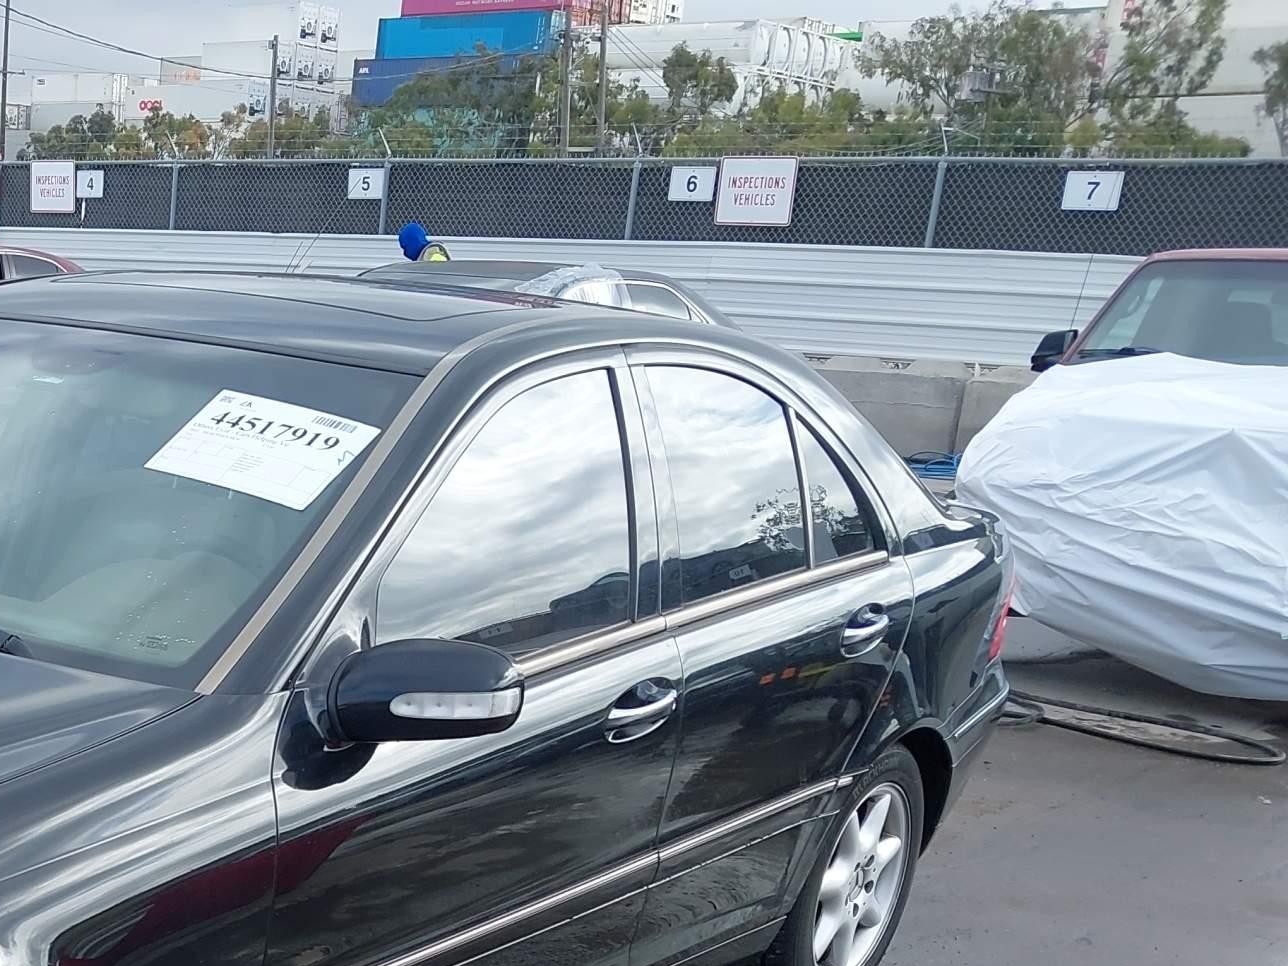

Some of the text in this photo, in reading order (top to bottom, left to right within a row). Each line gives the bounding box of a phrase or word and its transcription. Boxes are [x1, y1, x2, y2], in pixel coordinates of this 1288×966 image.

[35, 175, 70, 185] INSPECTIONS
[86, 177, 94, 191] 4
[361, 176, 371, 192] 5
[686, 174, 698, 193] 6
[727, 175, 787, 190] INSPECTIONS
[39, 188, 65, 198] VEHICLES
[1087, 181, 1101, 200] 7
[732, 193, 777, 207] VEHICLES
[211, 411, 341, 451] 44517919
